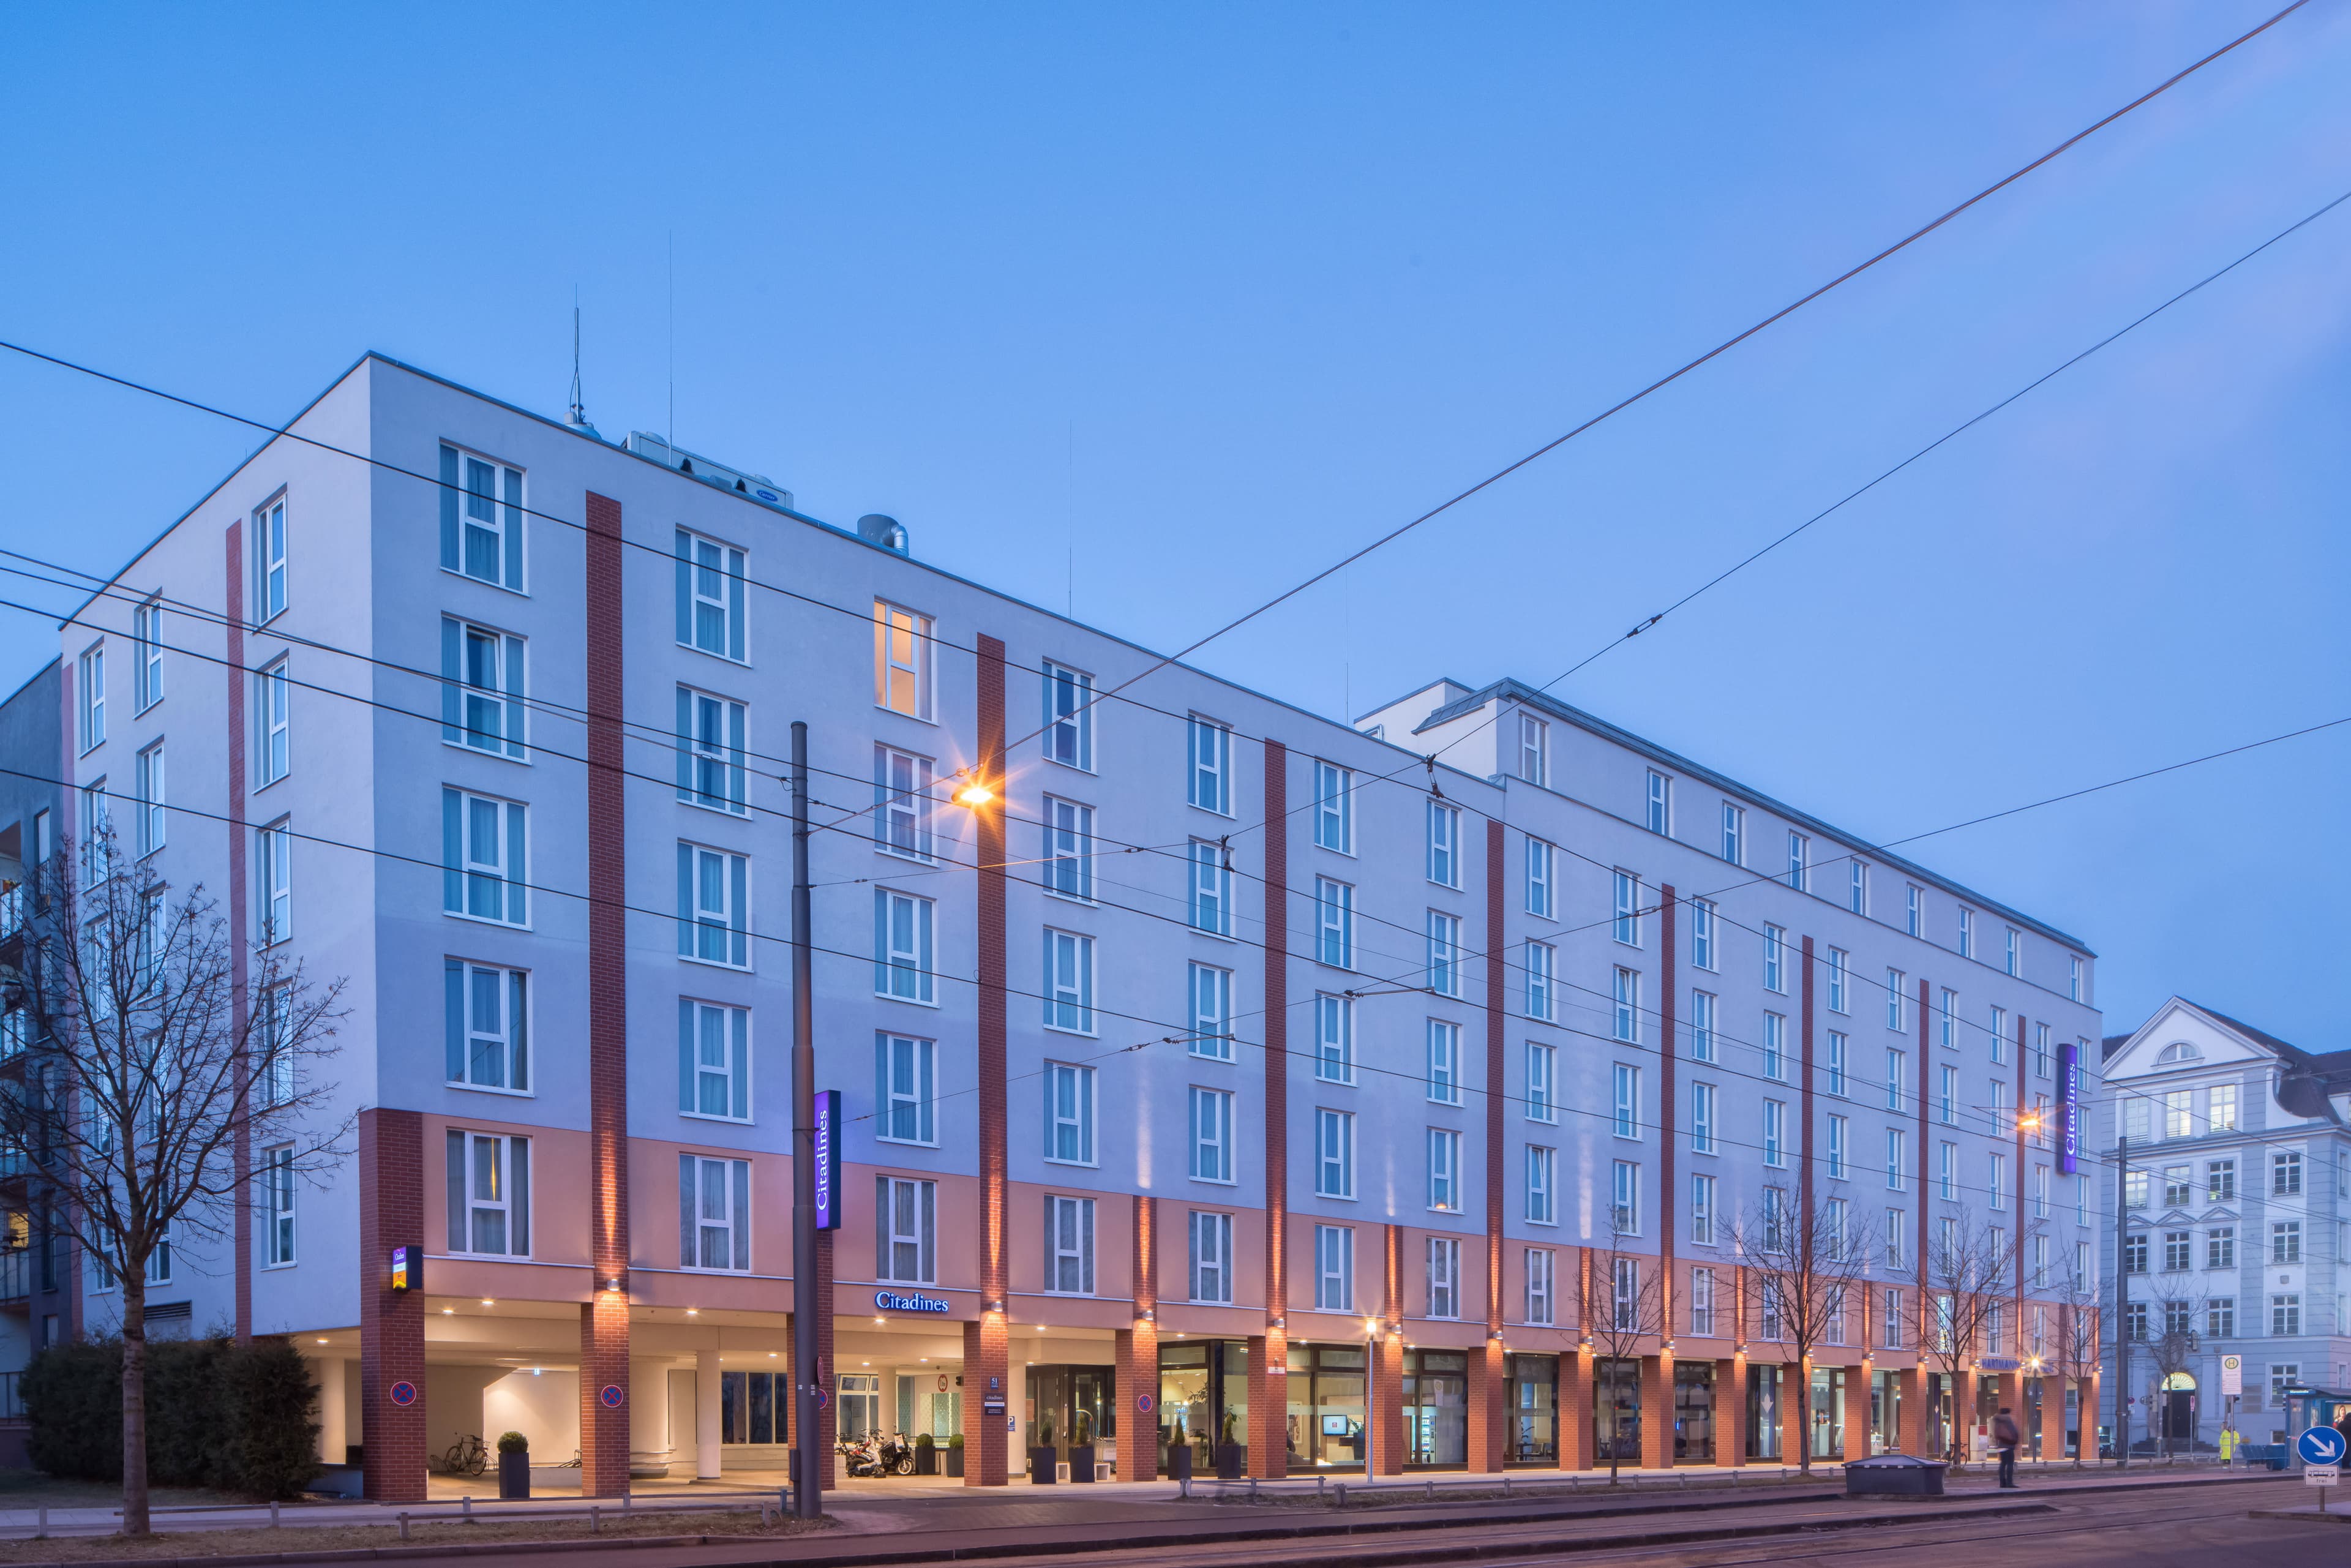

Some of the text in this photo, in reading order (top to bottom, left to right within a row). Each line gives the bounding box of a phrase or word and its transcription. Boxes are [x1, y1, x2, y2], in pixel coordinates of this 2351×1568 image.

[2066, 1063, 2075, 1155] Citadines
[816, 1109, 827, 1210] Citadines
[876, 1291, 949, 1312] Citadines
[1008, 1416, 1014, 1425] P
